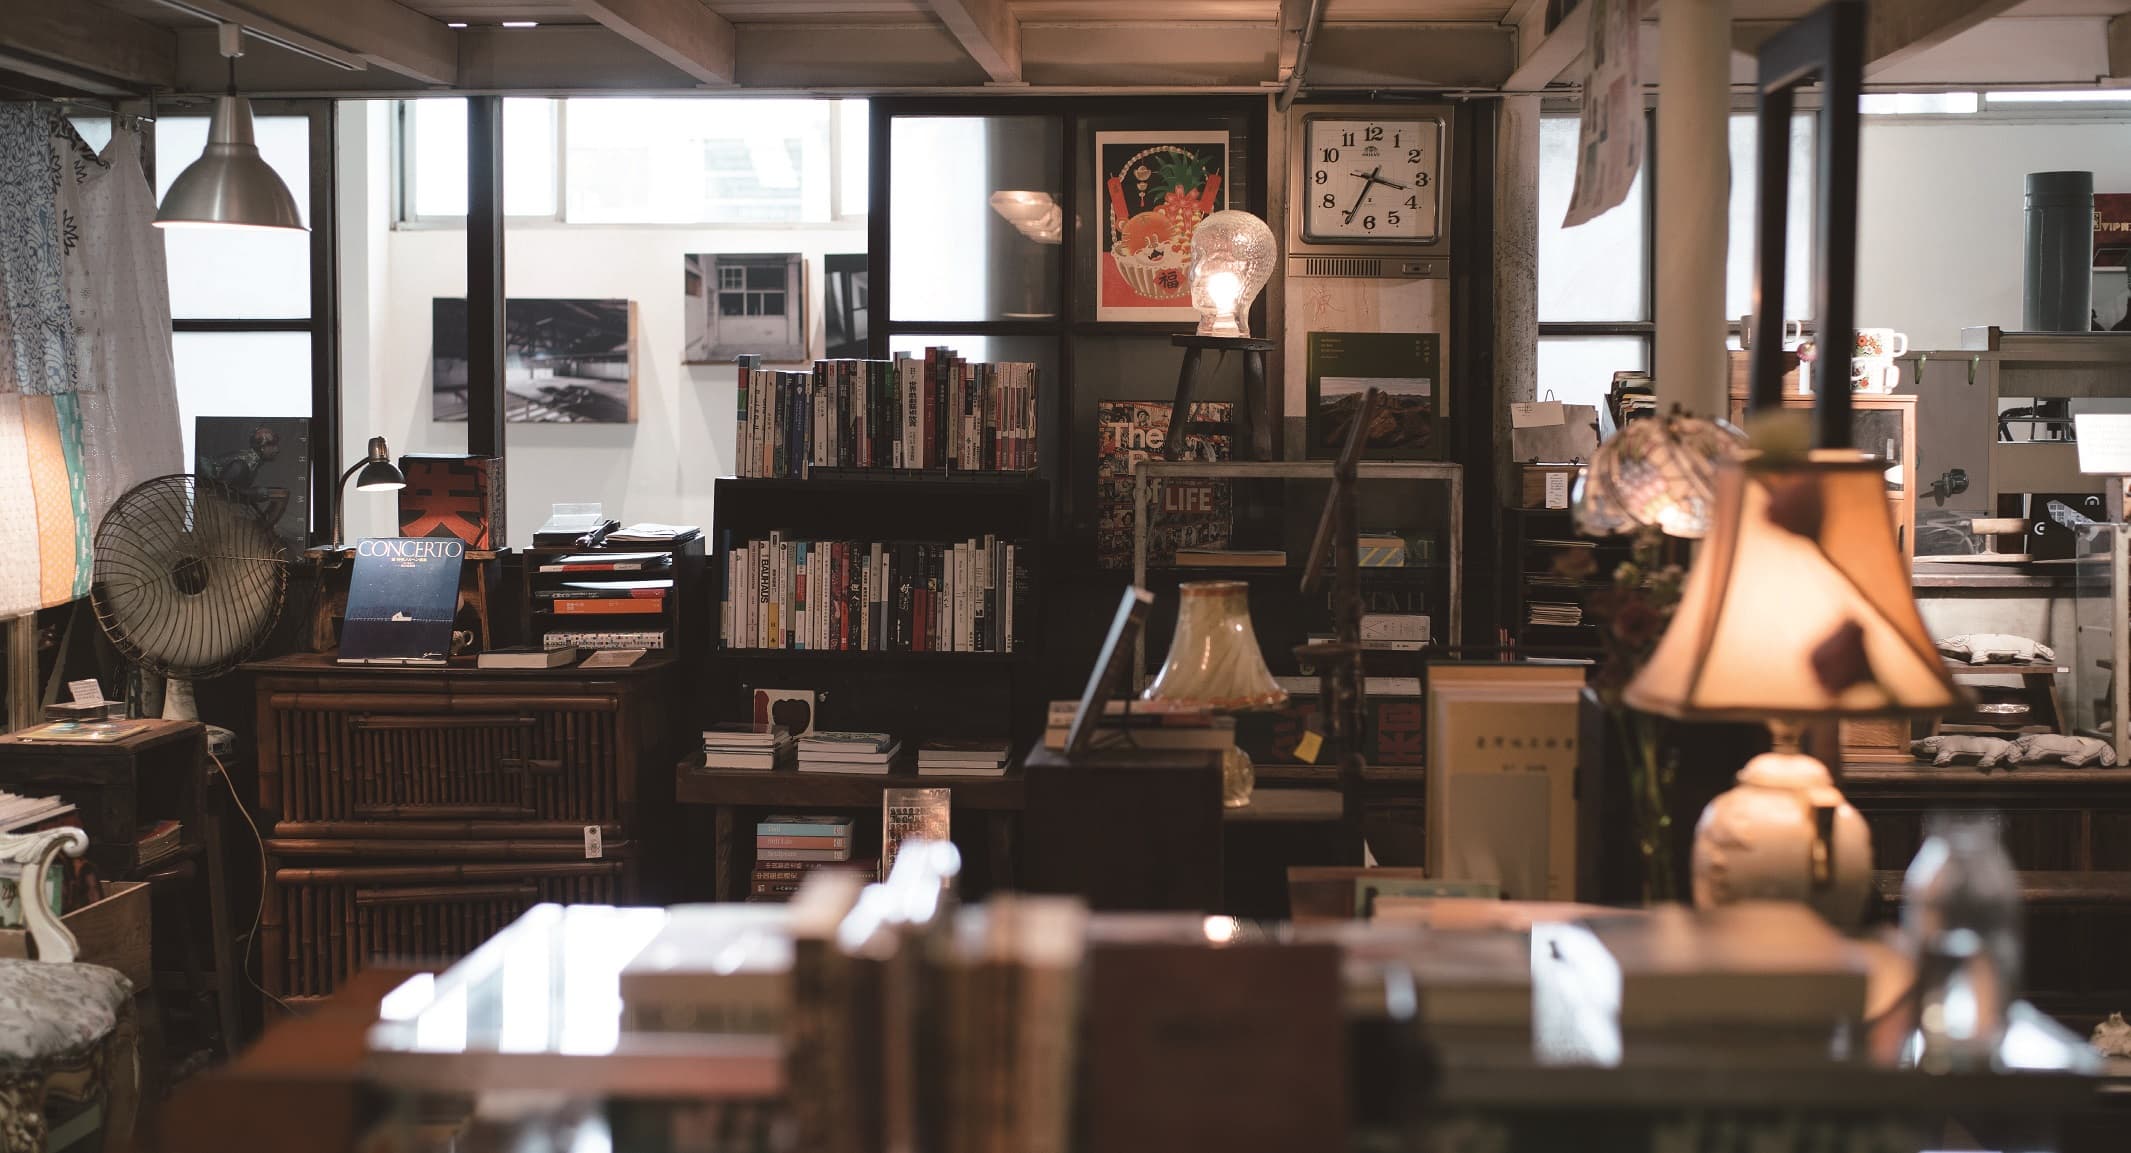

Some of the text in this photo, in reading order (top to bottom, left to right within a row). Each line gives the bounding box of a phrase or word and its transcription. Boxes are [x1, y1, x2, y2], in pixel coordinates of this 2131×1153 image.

[1342, 132, 1356, 147] 11
[1364, 126, 1384, 142] 12
[1393, 134, 1401, 148] 1
[1322, 148, 1339, 163] 10
[1408, 149, 1421, 164] 2
[1315, 170, 1328, 184] 9
[1415, 173, 1428, 187] 3
[1323, 194, 1335, 208] 8
[1404, 196, 1417, 209] 4
[1363, 216, 1376, 229] 6
[1388, 211, 1400, 225] 5
[1158, 271, 1179, 290] 福
[1108, 422, 1165, 449] The
[1165, 487, 1212, 511] LIFE
[358, 540, 462, 558] CONCERTO
[761, 559, 769, 604] BAUHAUS
